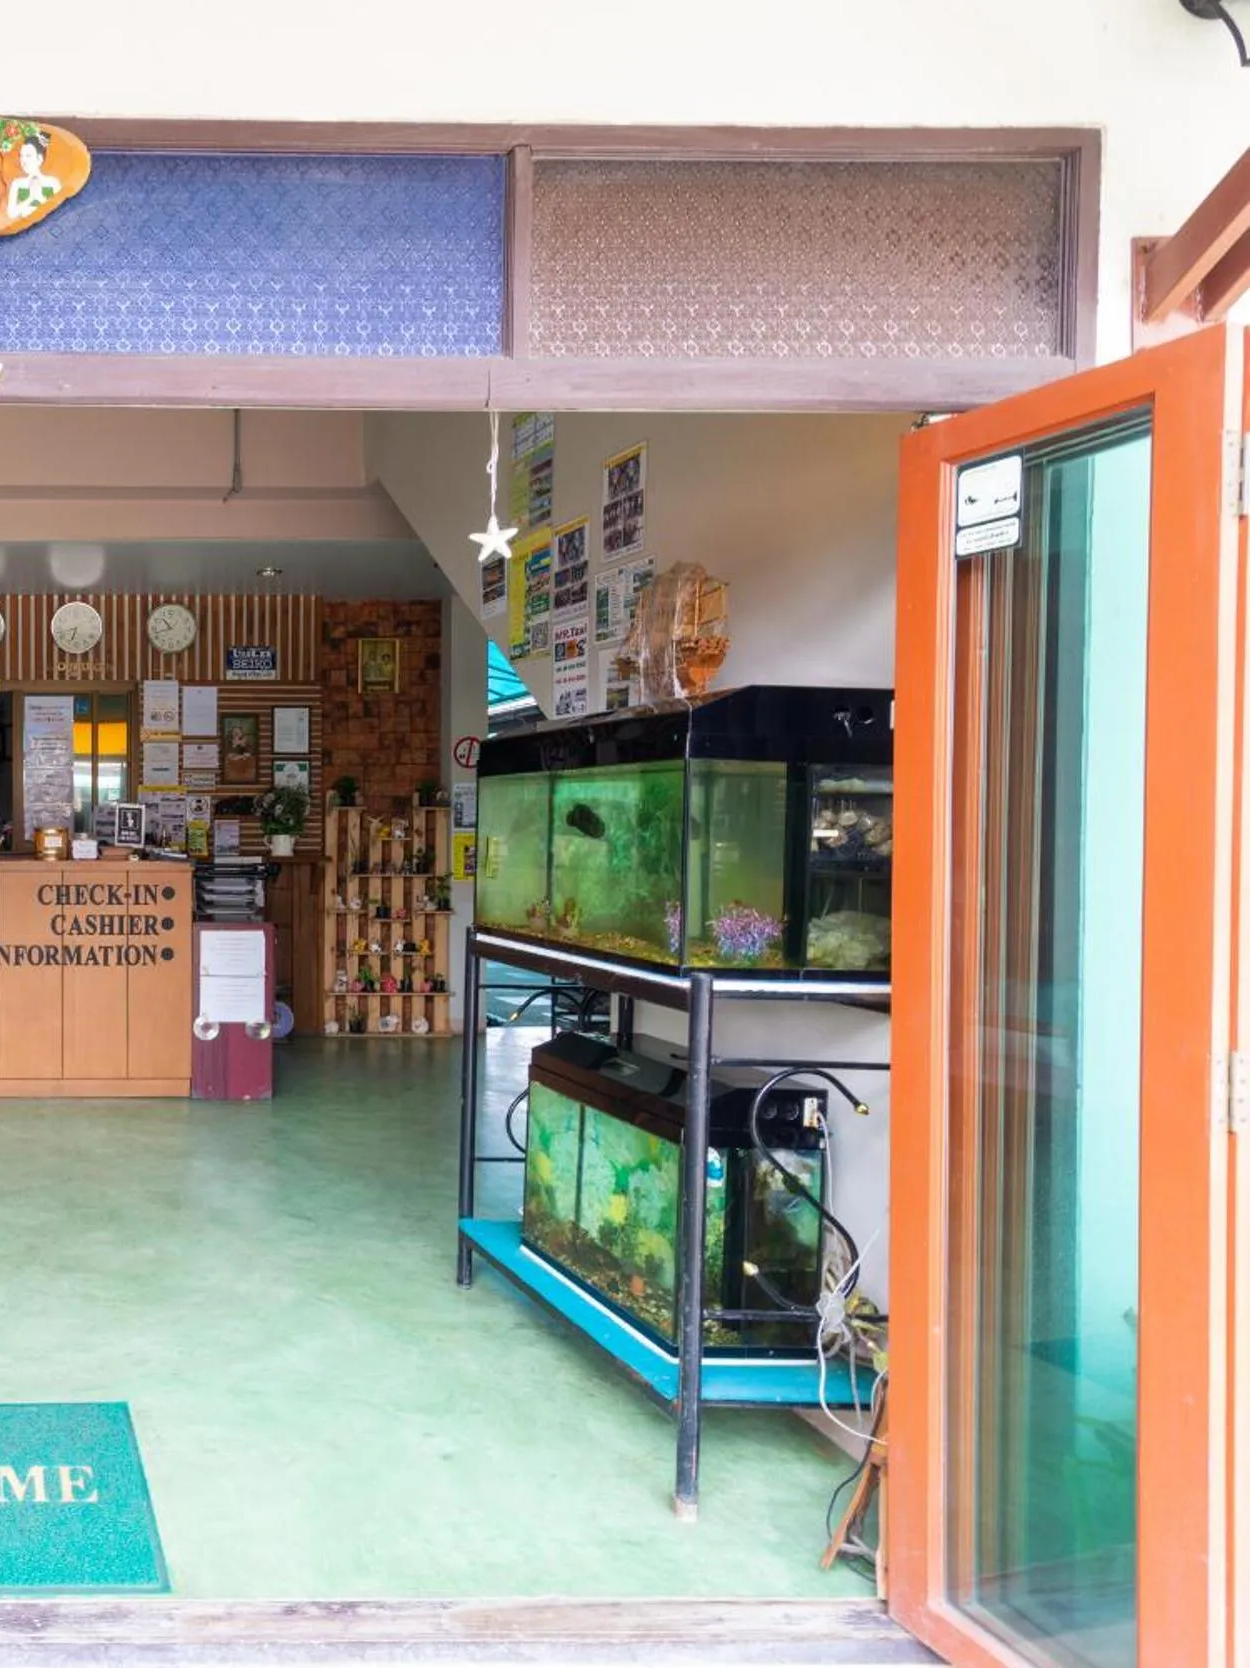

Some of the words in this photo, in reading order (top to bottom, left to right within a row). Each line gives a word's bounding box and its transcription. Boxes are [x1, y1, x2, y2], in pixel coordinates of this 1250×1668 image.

[232, 659, 273, 670] SEIKO
[37, 884, 159, 905] CHECK-IN
[50, 914, 159, 935] CASHIER
